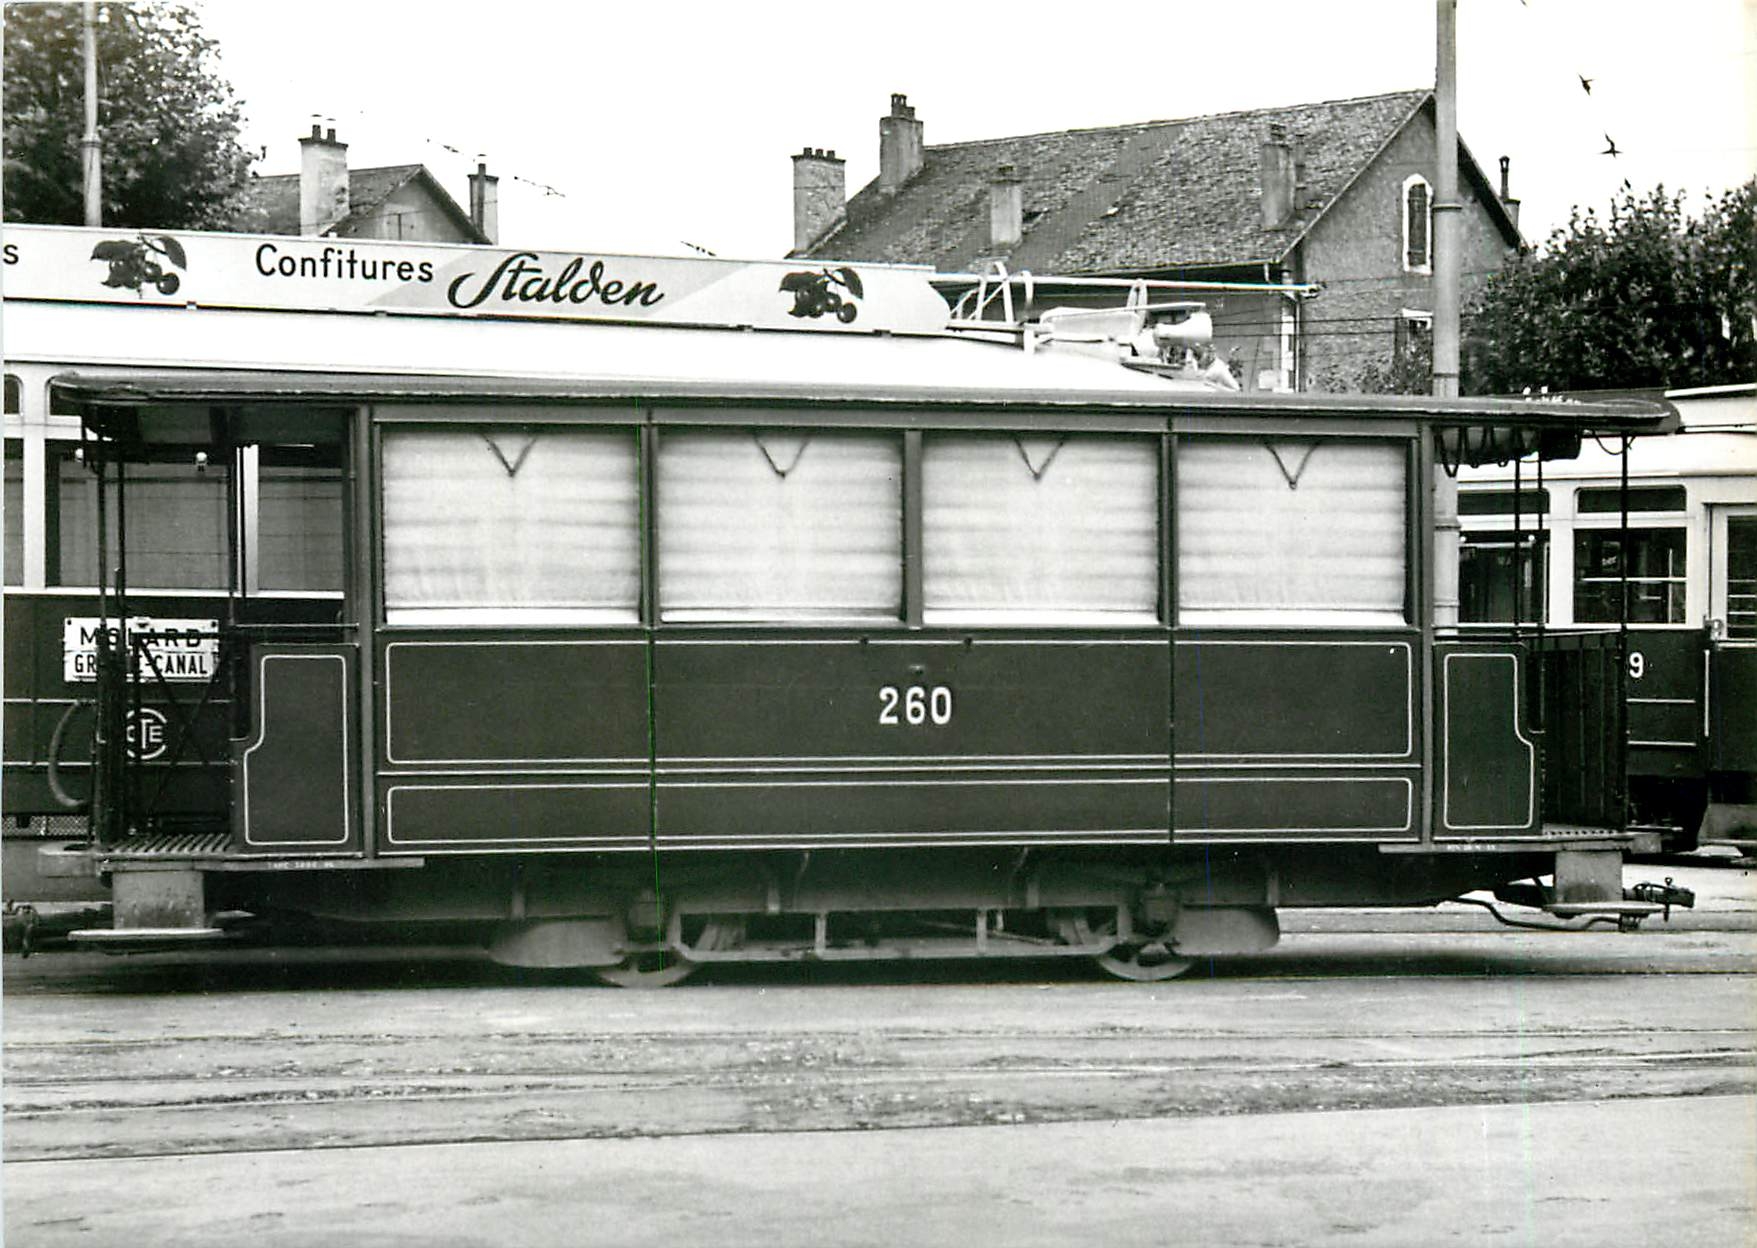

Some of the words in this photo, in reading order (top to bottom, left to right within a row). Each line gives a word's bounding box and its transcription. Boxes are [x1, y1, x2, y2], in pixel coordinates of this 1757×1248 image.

[255, 243, 434, 283] Confitures
[447, 251, 667, 308] Stalden
[75, 653, 208, 674] GR-CANAL
[1629, 652, 1644, 679] 9
[879, 686, 952, 725] 260
